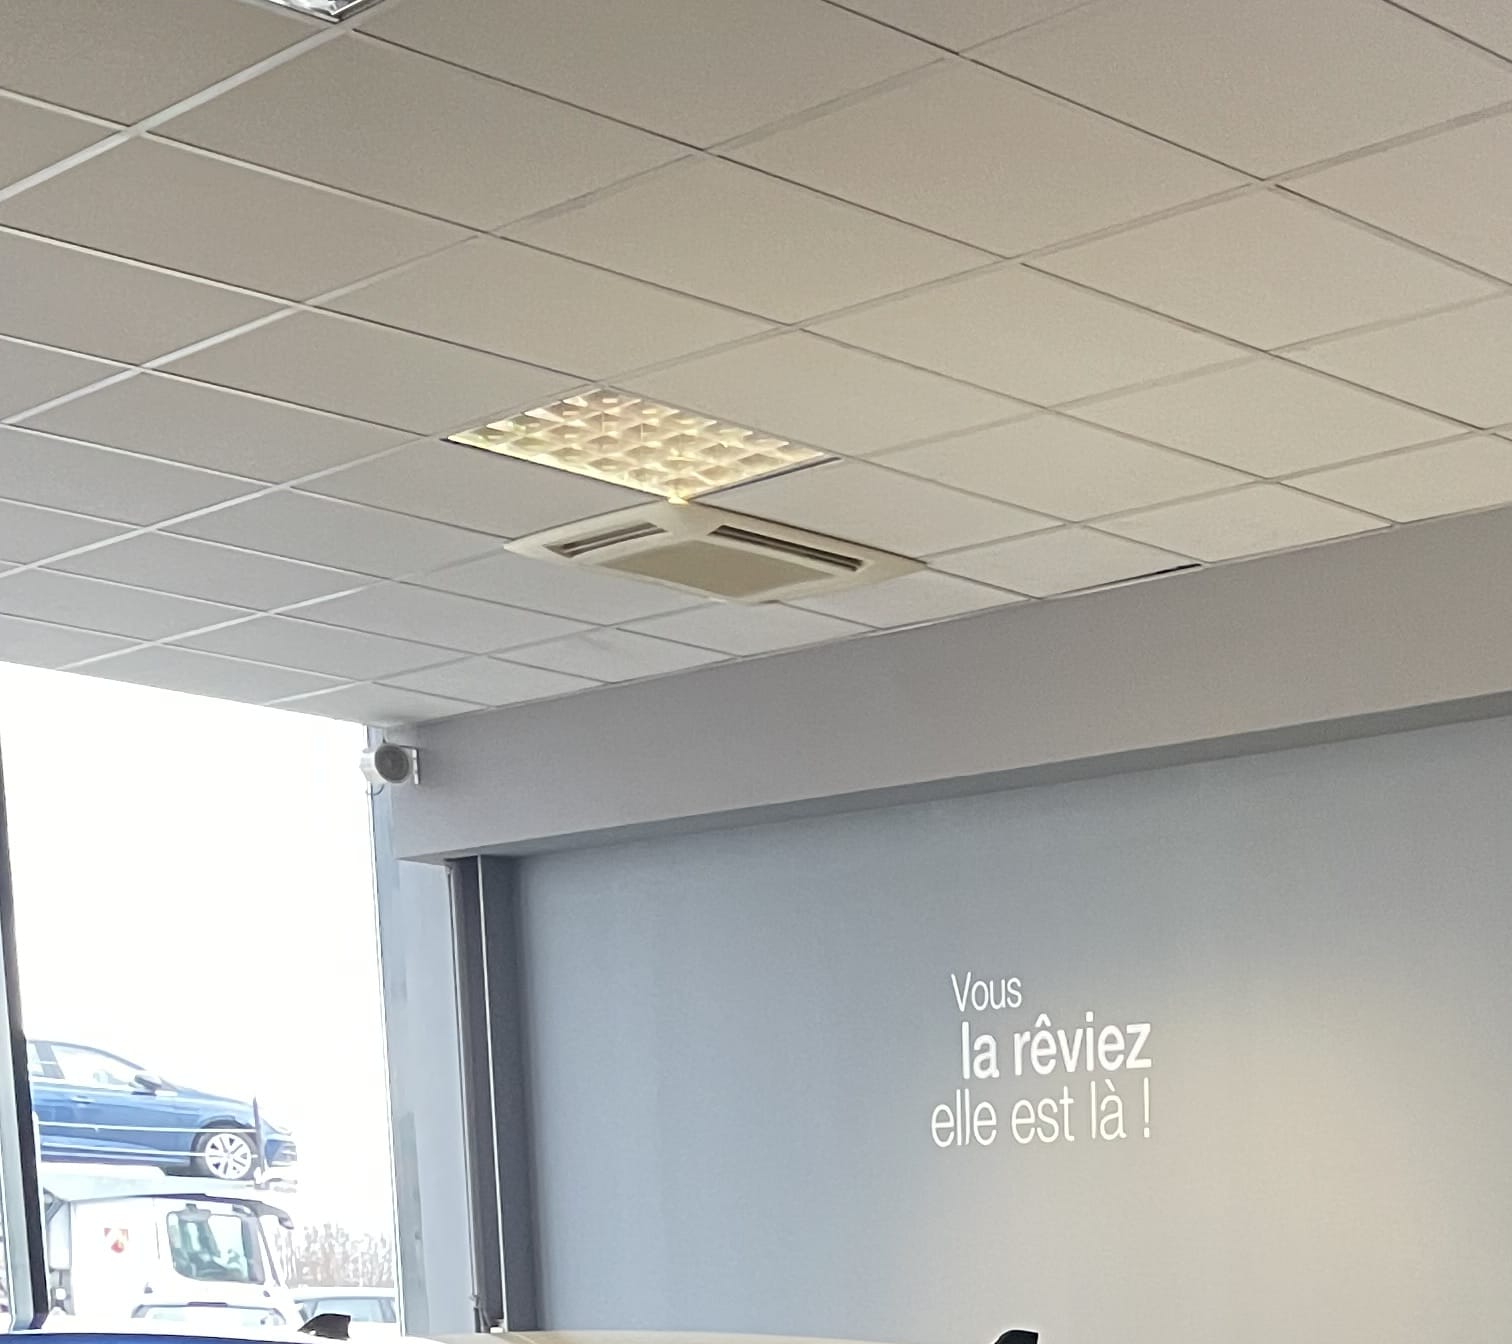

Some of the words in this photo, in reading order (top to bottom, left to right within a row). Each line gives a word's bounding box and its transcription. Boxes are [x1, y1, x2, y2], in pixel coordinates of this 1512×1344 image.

[950, 971, 1023, 1013] Vous
[961, 1021, 1000, 1080] la
[1013, 1011, 1152, 1076] rêviez
[931, 1087, 998, 1148] elle
[1011, 1085, 1075, 1145] est
[1090, 1078, 1127, 1141] là
